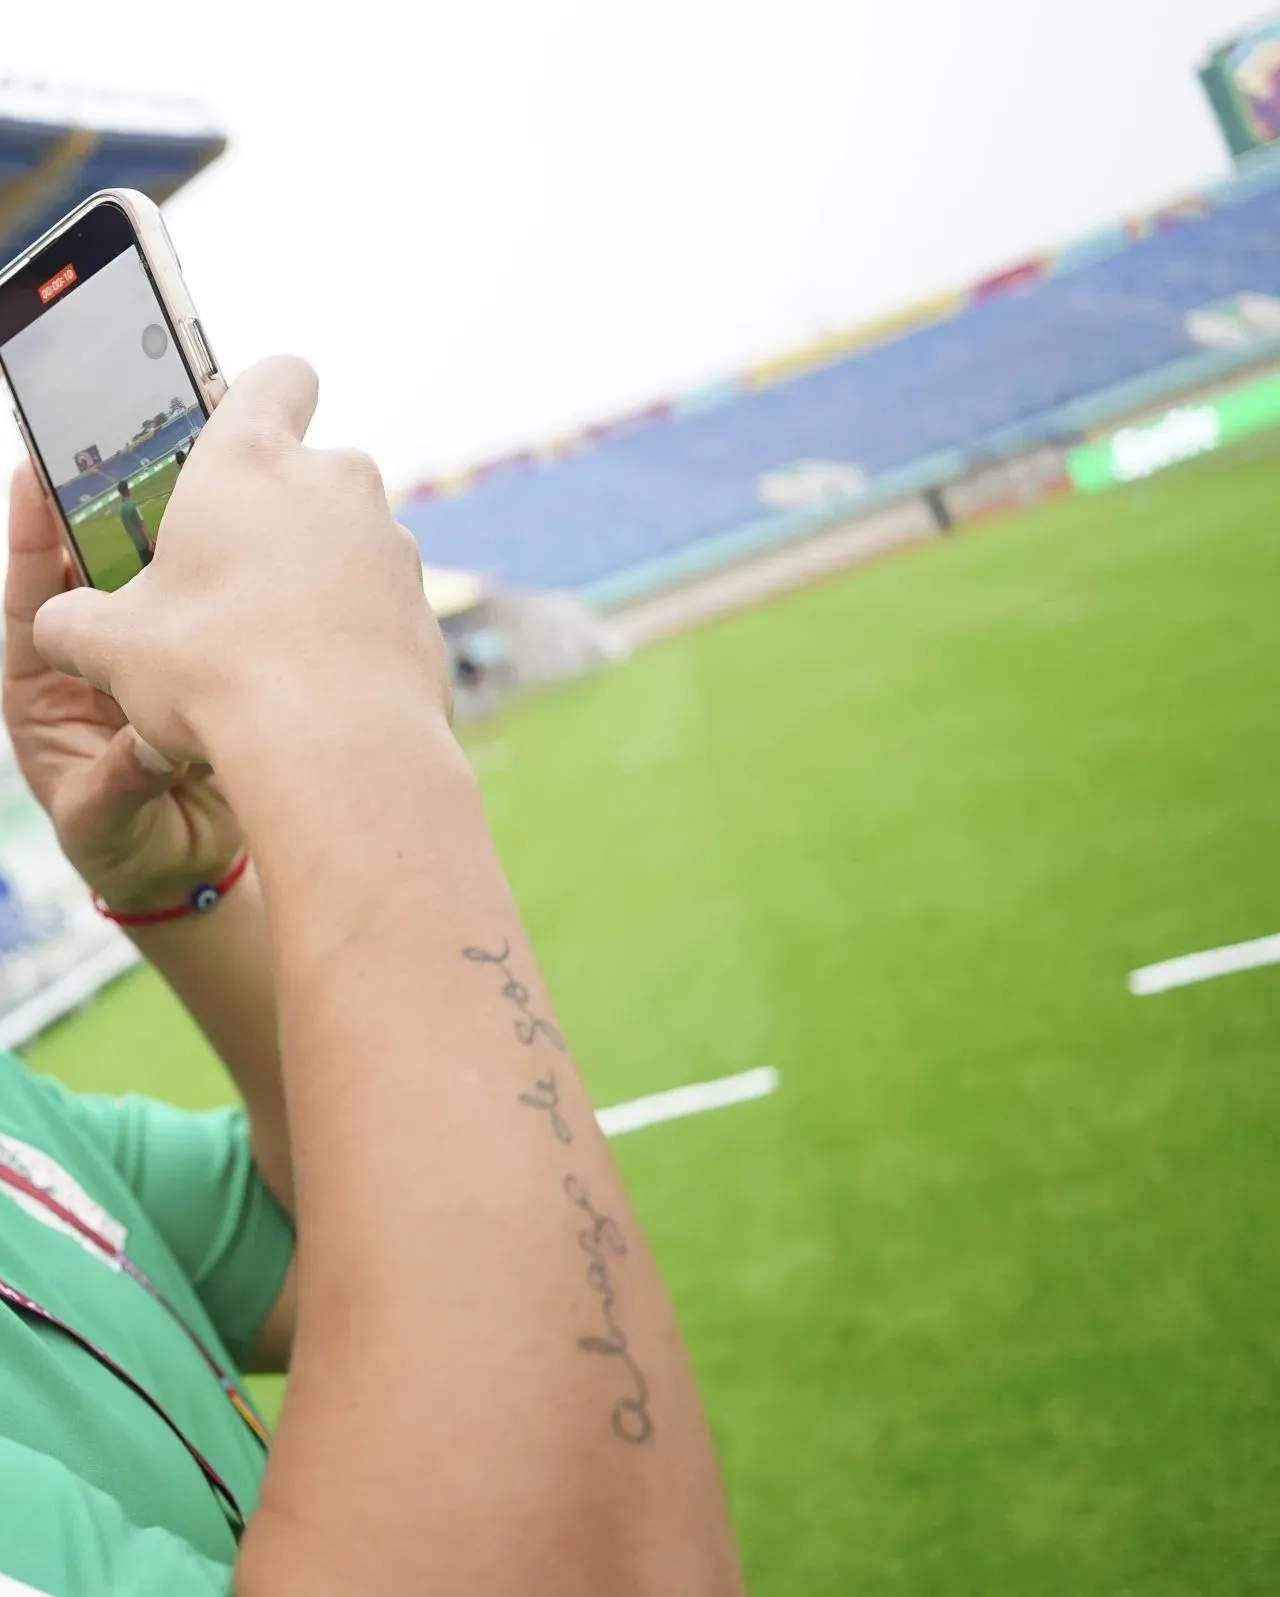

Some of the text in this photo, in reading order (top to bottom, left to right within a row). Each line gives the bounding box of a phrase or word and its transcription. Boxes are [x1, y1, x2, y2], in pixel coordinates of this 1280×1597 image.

[461, 936, 654, 1445] abrazo de gol
